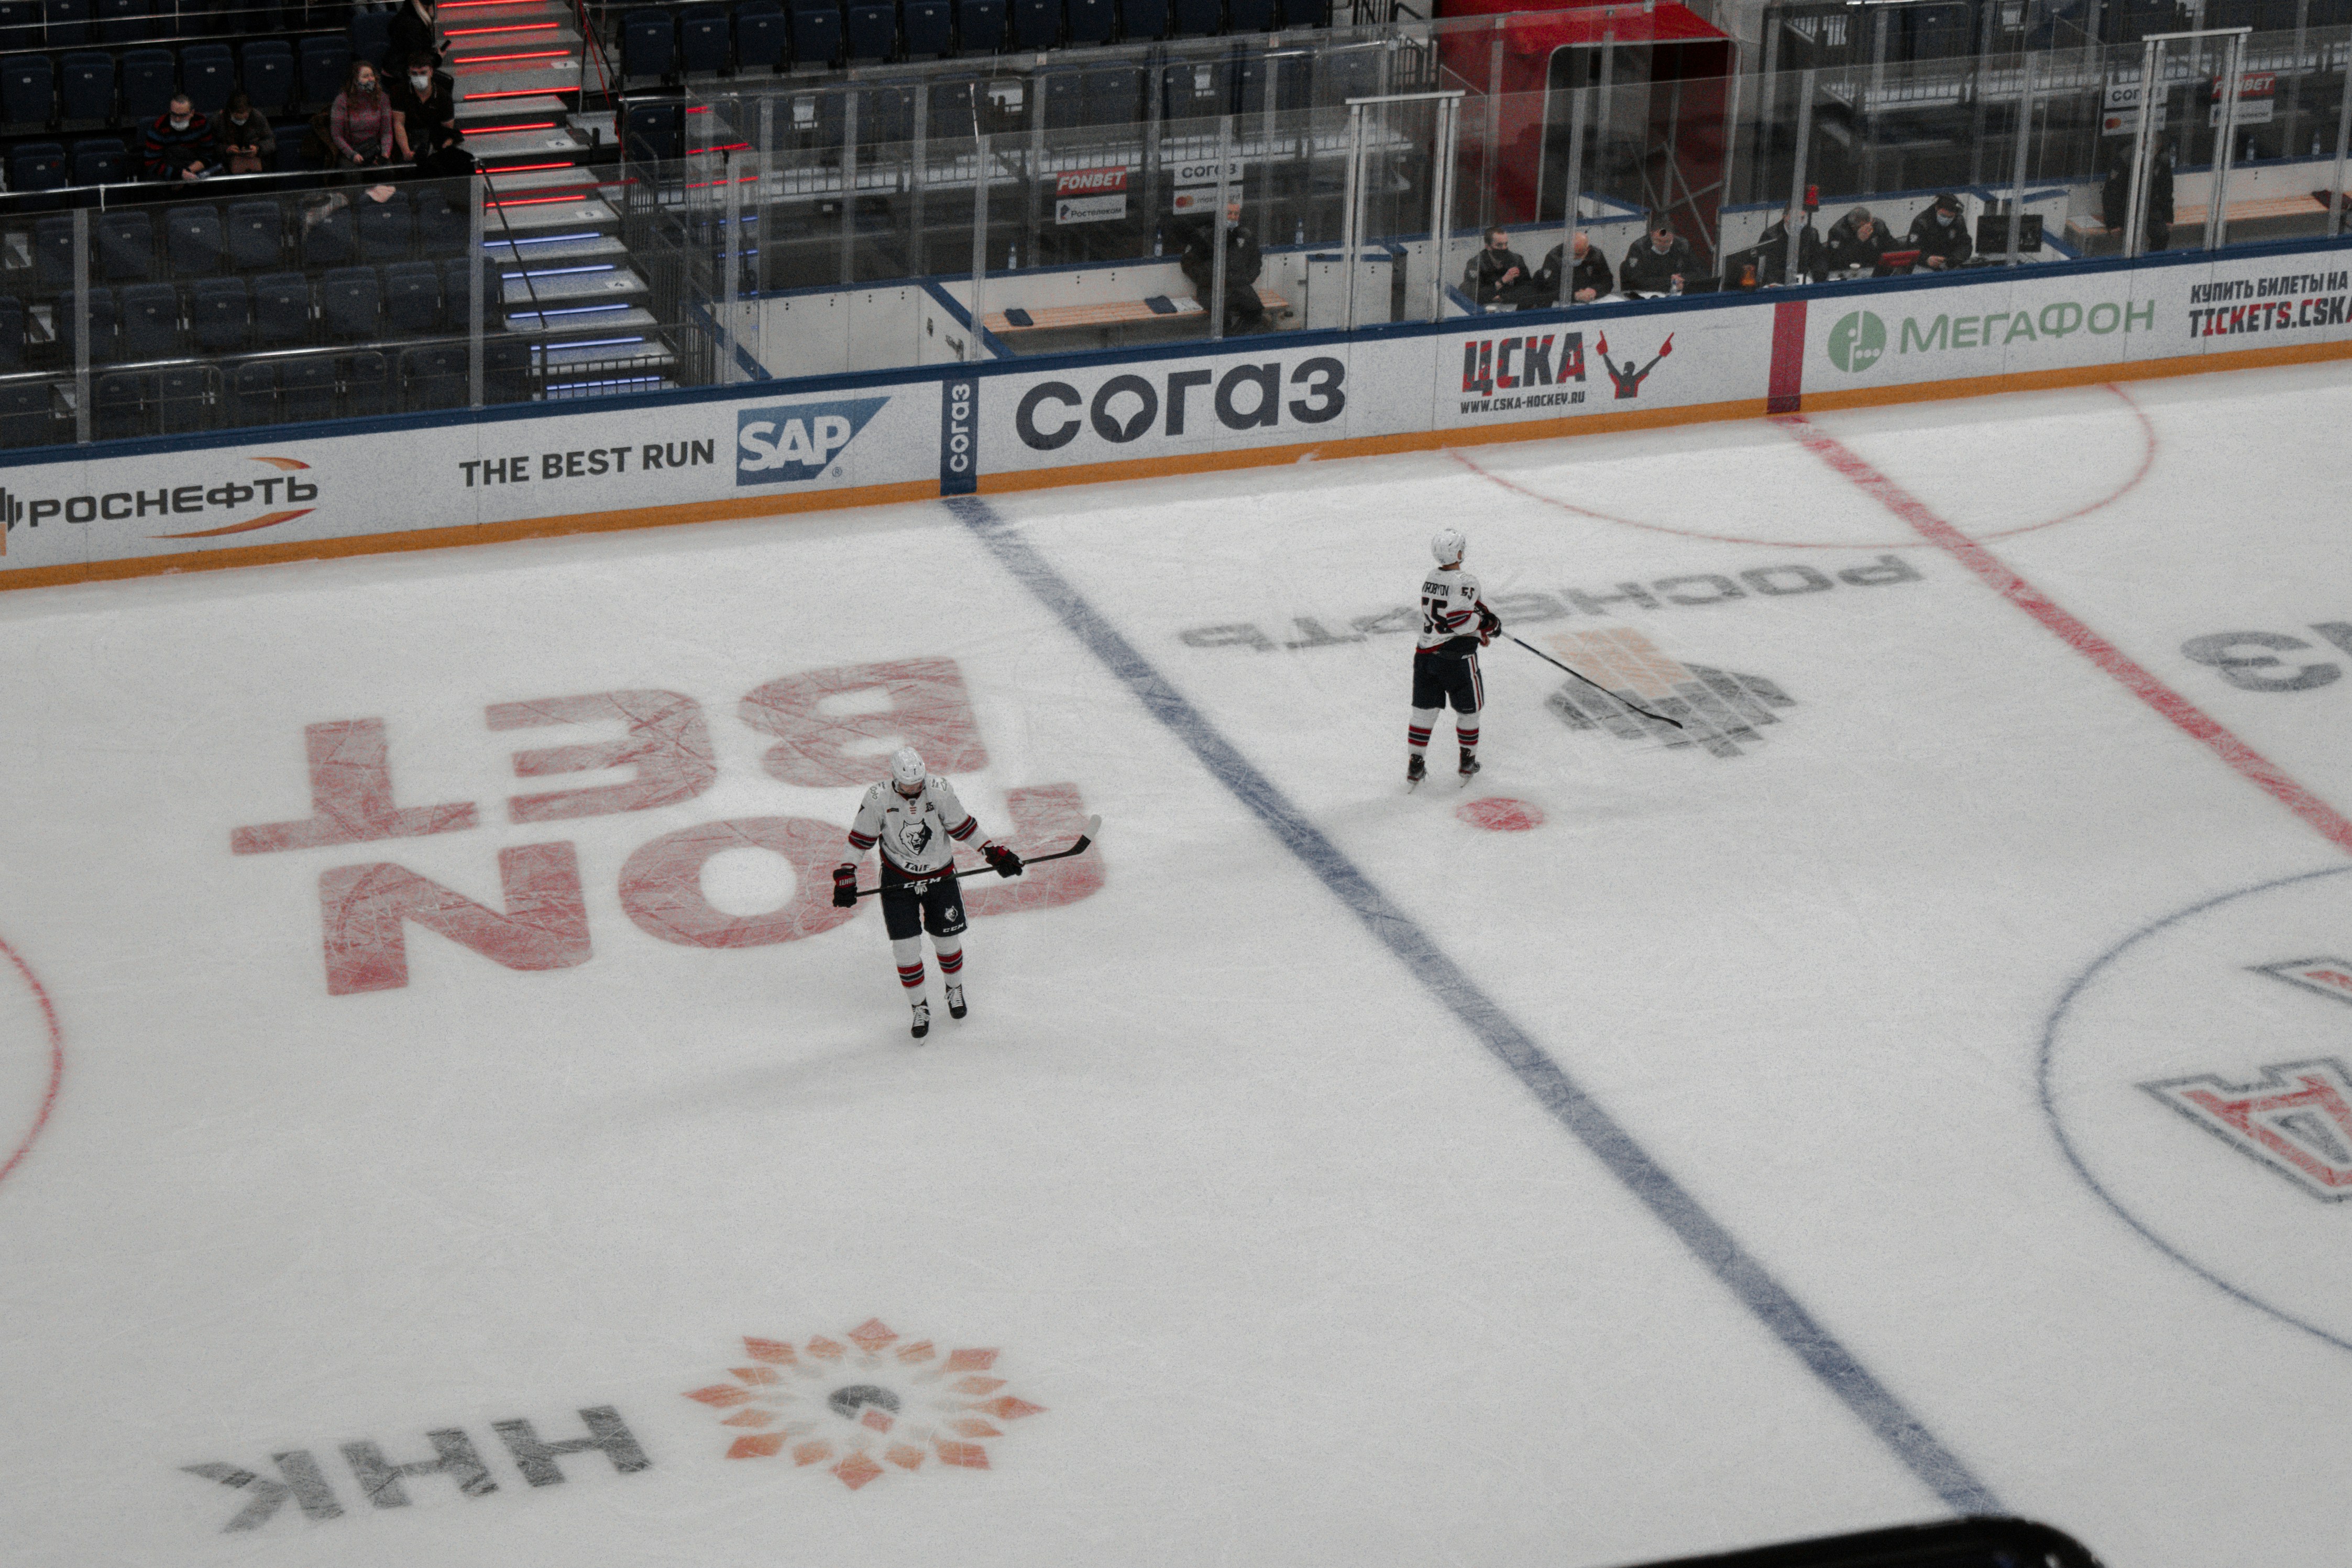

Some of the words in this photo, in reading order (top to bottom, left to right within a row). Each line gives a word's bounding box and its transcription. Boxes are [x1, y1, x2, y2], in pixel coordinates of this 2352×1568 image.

[1057, 171, 1125, 191] FONBET
[1071, 208, 1122, 218] Ростелеком
[2191, 280, 2254, 304] КУПИТЬ
[2257, 273, 2324, 297] БИЛЕТЫ
[2327, 271, 2348, 291] НА
[1462, 332, 1586, 396] ЦСКА
[1460, 391, 1585, 414] WWW.CSKA-HOCKEY.RU
[739, 415, 851, 472] SAP
[459, 456, 530, 487] THE
[542, 446, 632, 479] BEST
[643, 439, 715, 470] RUN
[29, 476, 318, 527] РОСНЕФТЬ
[1461, 587, 1475, 601] 55
[229, 656, 990, 856] BET
[904, 876, 942, 889] CCM
[943, 923, 964, 933] CCM
